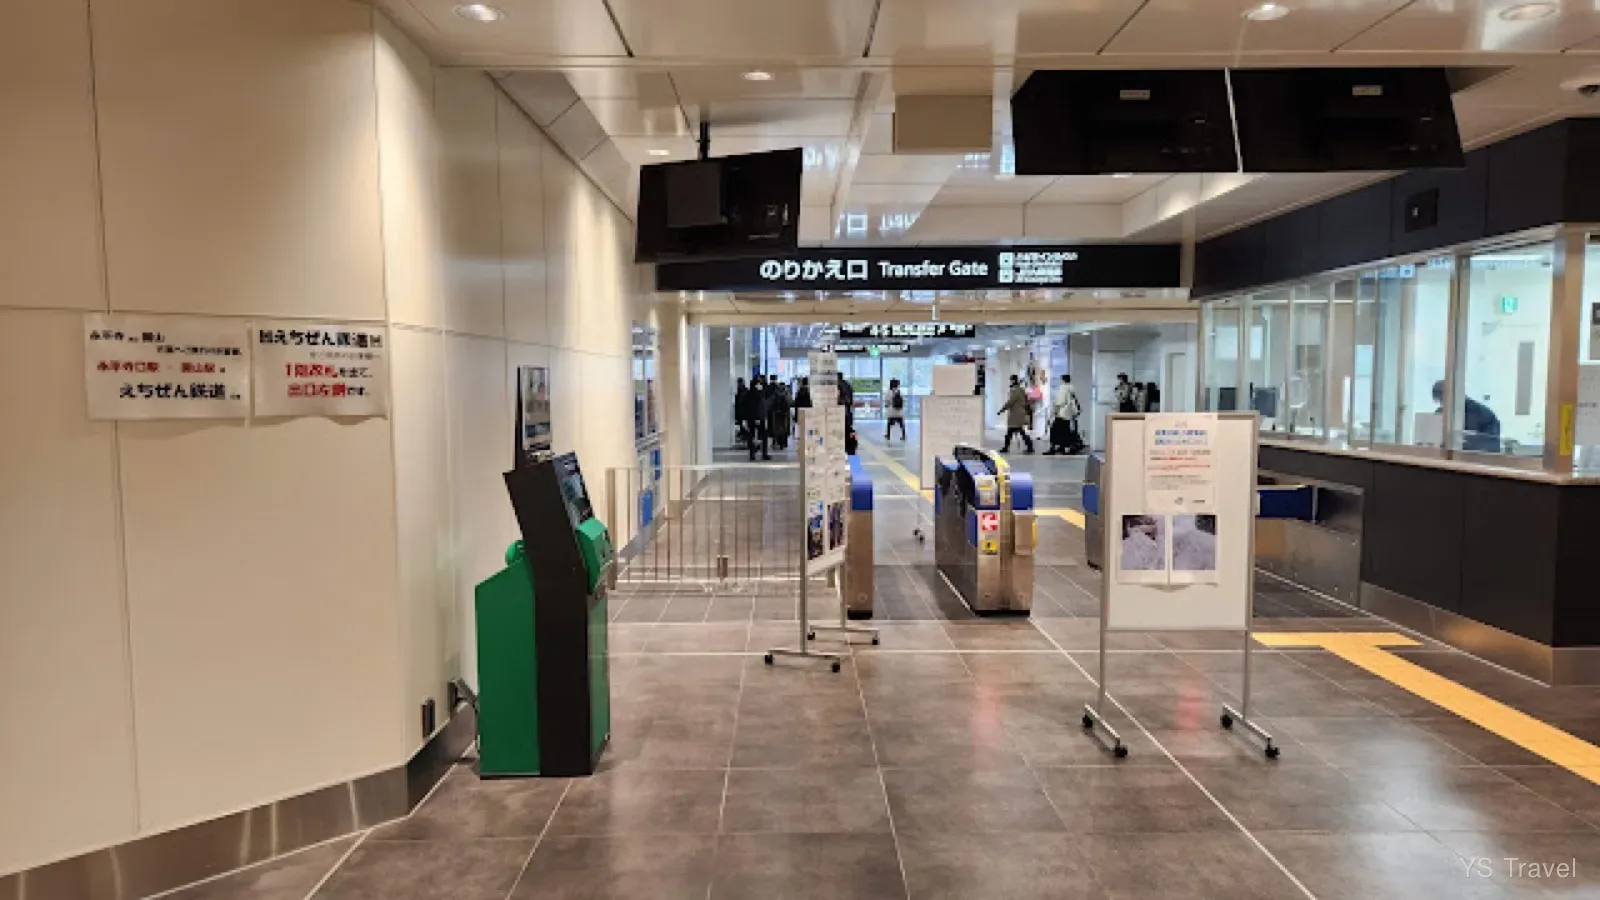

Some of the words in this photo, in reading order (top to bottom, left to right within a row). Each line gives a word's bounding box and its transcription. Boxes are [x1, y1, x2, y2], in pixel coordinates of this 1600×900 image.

[759, 259, 869, 281] のりかえ口
[877, 261, 945, 277] Transfer
[949, 260, 989, 277] Gate
